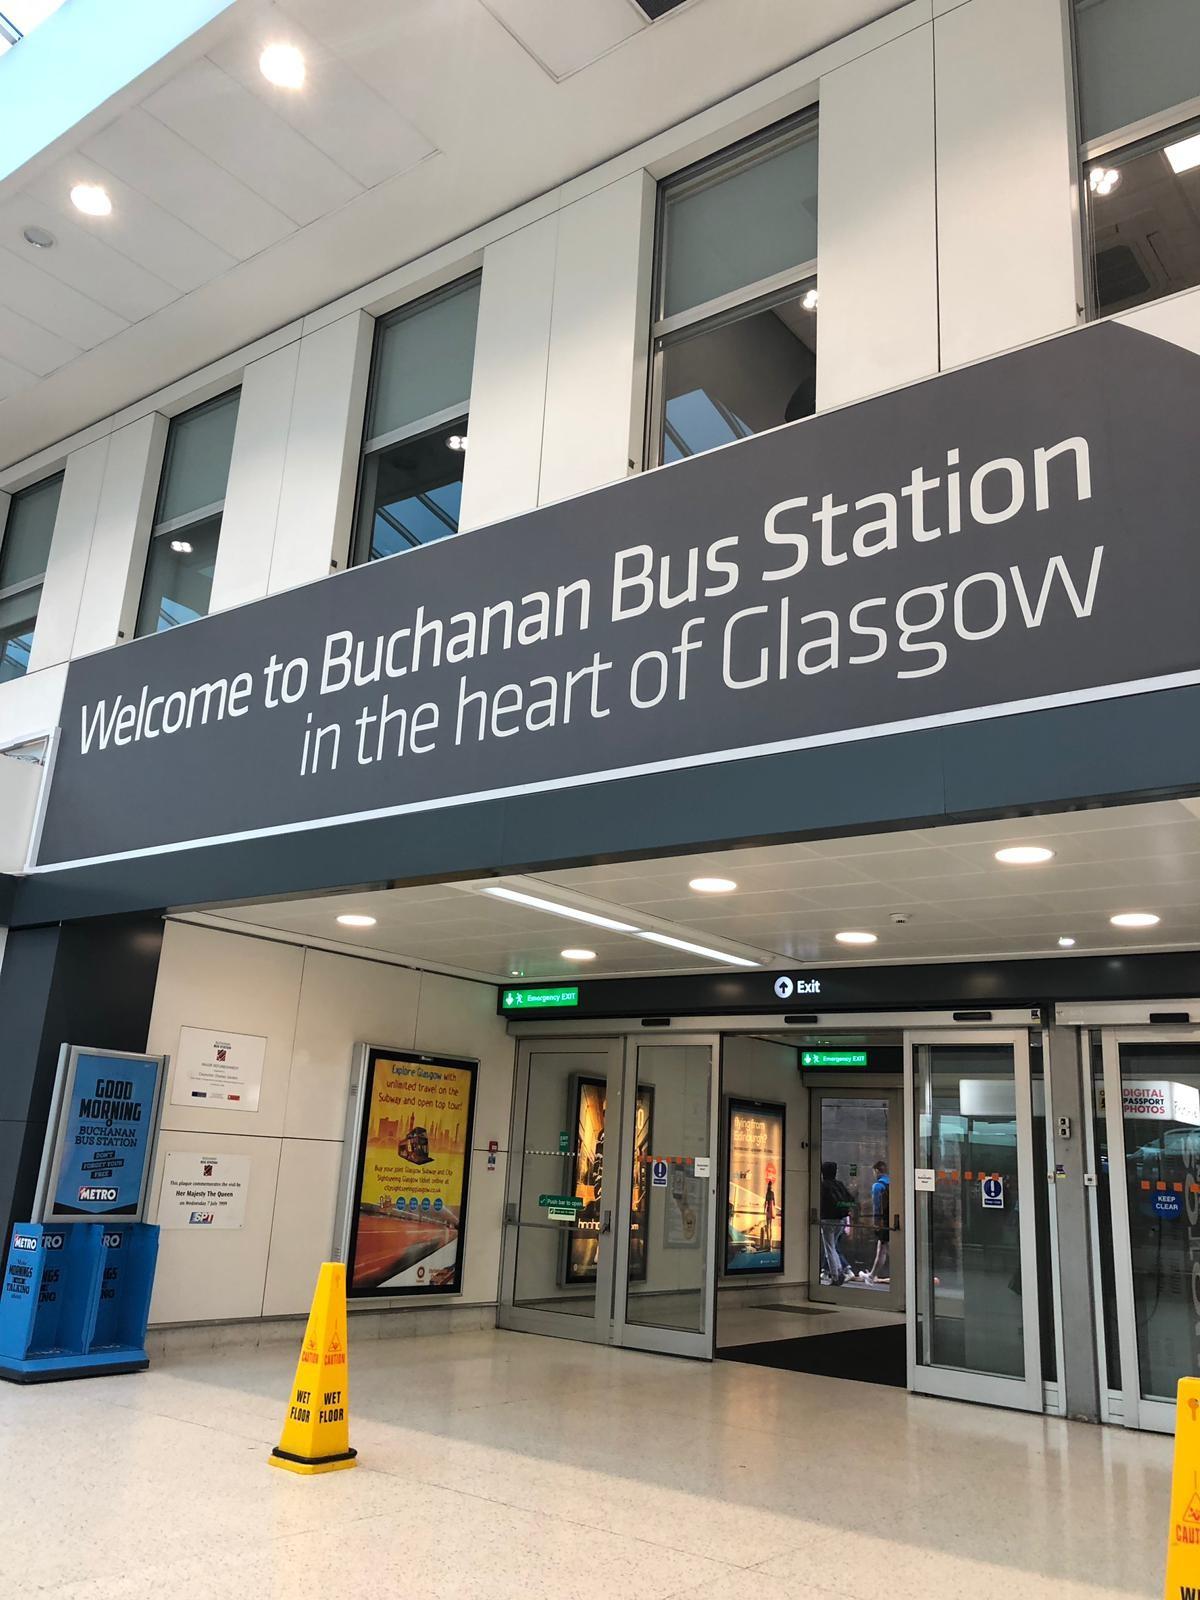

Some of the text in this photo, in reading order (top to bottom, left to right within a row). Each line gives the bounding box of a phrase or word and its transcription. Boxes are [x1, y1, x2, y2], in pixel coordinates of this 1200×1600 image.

[81, 437, 1091, 745] Welcome to Buchanan Bus Station
[301, 546, 1104, 775] in the heart of Glasgow
[797, 980, 820, 994] Exit
[527, 992, 576, 1003] Emergency EXIT
[822, 1055, 852, 1063] Emergency
[392, 1064, 457, 1082] Explore Glasgow with
[95, 1078, 133, 1099] GOOD
[386, 1079, 459, 1097] unlimited travel on the
[1123, 1088, 1164, 1098] DIGITAL
[378, 1092, 402, 1105] Subway
[403, 1096, 416, 1106] and
[417, 1098, 433, 1108] open
[435, 1099, 446, 1110] top
[79, 1098, 141, 1121] MORNING
[1124, 1105, 1165, 1114] PHOTOS
[79, 1126, 137, 1138] BUCHANAN
[74, 1135, 138, 1147] BUS STATION
[80, 1187, 116, 1200] METRO
[186, 1190, 206, 1198] Majesty
[14, 1235, 37, 1250] METRO
[6, 1282, 30, 1295] TALKING
[302, 1351, 318, 1363] CAUTION
[324, 1353, 345, 1366] CAUTION
[297, 1390, 311, 1404] WET
[324, 1391, 342, 1405] WET
[290, 1407, 311, 1423] FLOOR
[319, 1408, 344, 1424] FLOOR
